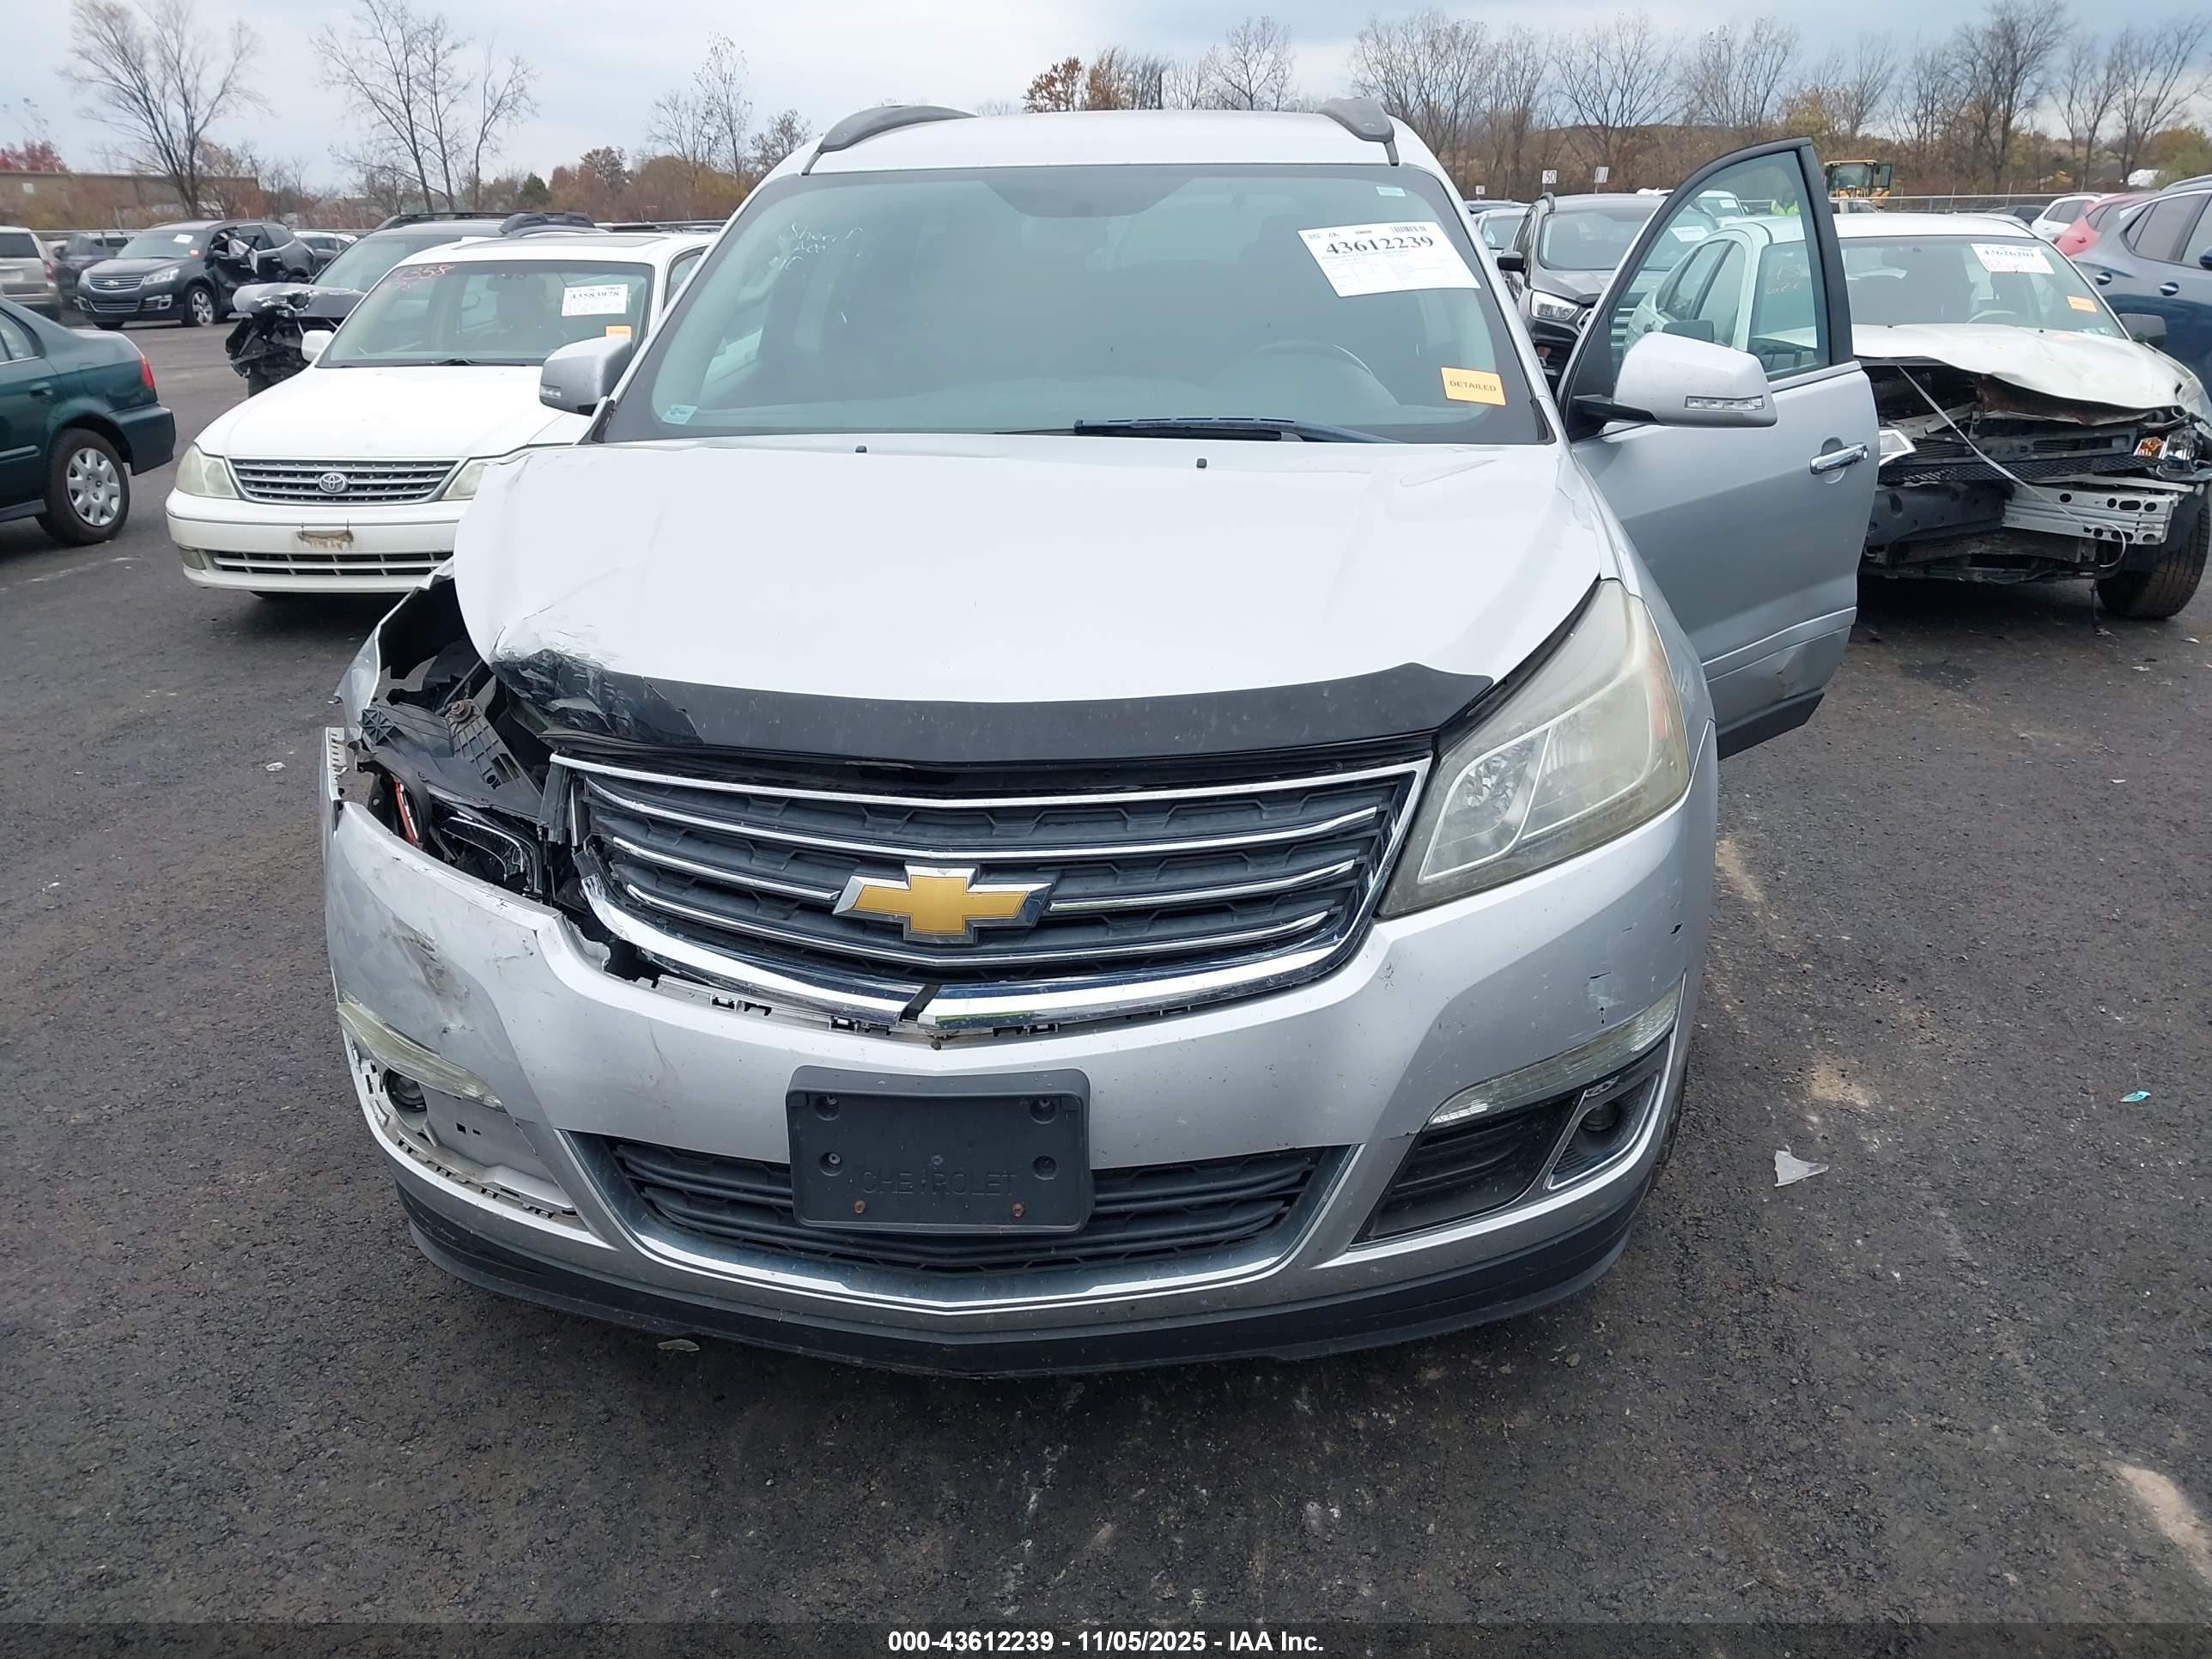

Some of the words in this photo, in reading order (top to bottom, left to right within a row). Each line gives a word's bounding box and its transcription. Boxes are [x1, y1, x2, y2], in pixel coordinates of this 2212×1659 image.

[1326, 235, 1434, 254] 43612239
[1449, 380, 1497, 392] DETAILED
[861, 1170, 1018, 1196] CHEVROLET
